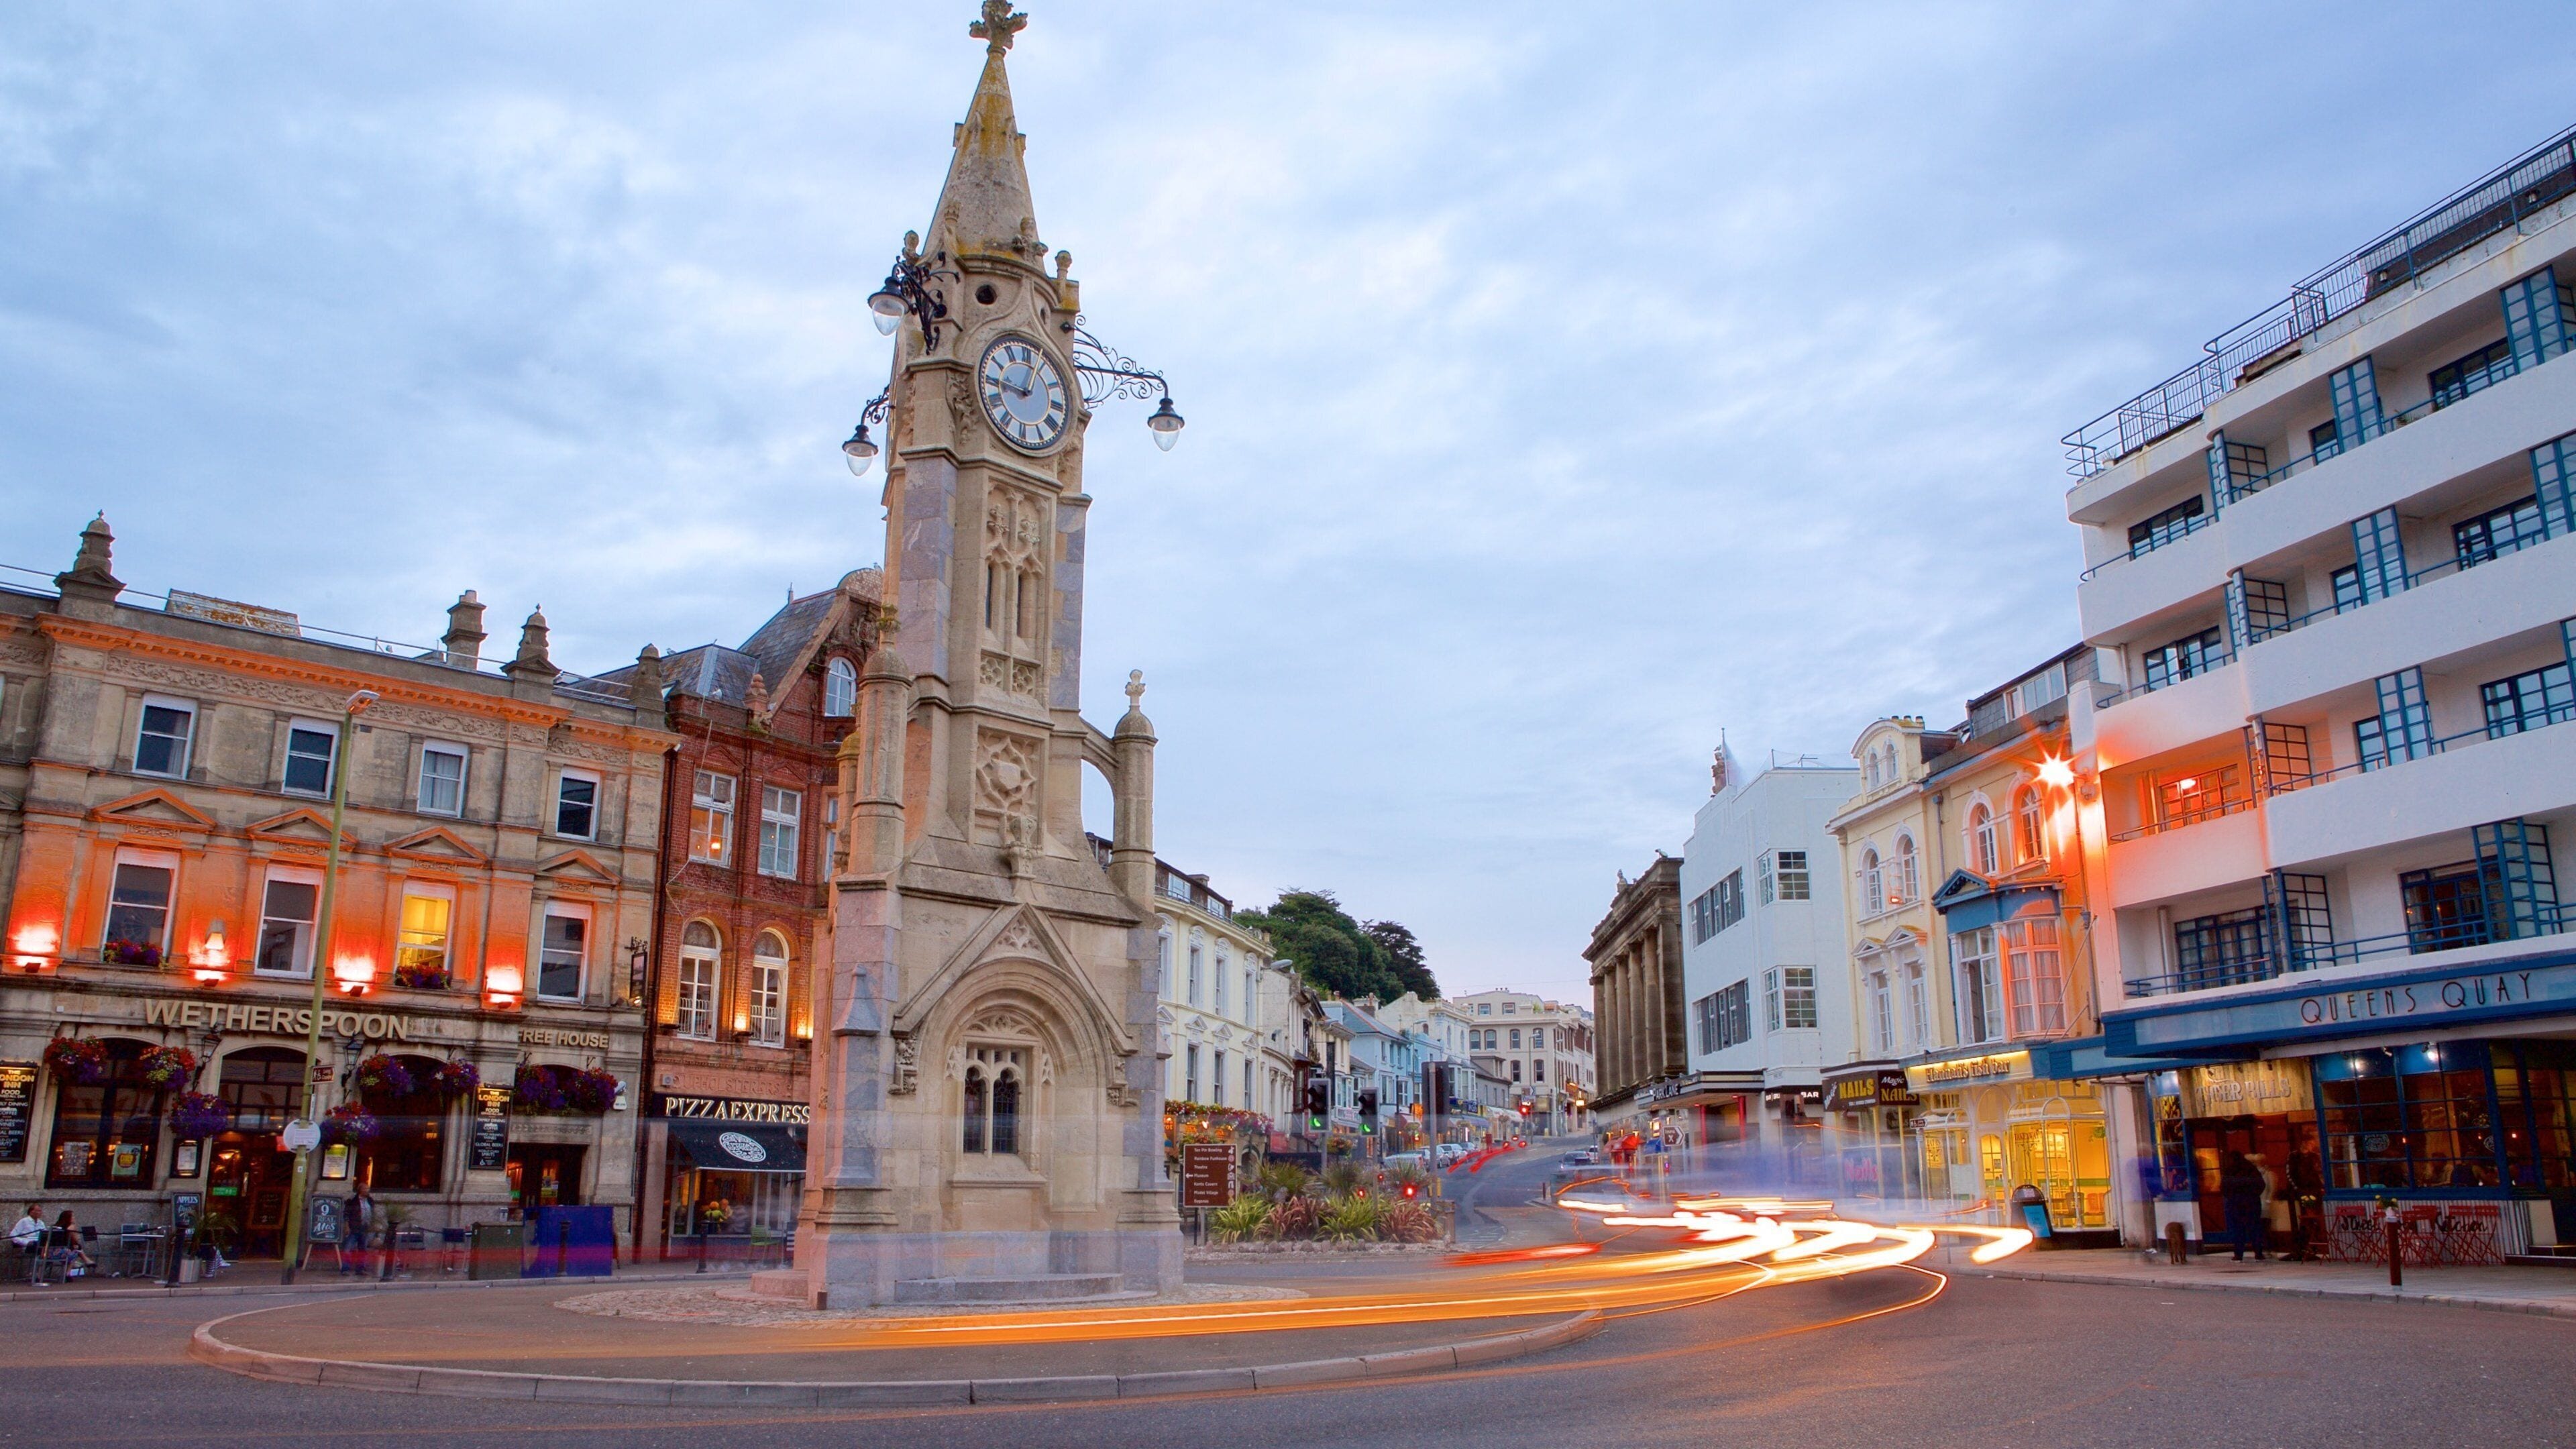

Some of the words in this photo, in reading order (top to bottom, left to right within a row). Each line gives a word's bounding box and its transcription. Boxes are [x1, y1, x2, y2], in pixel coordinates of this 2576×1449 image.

[2301, 987, 2416, 1024] QUEENS
[2442, 973, 2530, 1008] QUAY
[145, 999, 409, 1039] WETHERSPOON
[557, 1030, 609, 1048] HOUSE
[0, 1074, 35, 1082] ONDON
[1925, 1063, 1969, 1083] Hannah's
[1970, 1059, 1990, 1077] fish
[1992, 1058, 2010, 1073] bar
[1838, 1079, 1876, 1099] NAILS
[1881, 1076, 1904, 1087] Magic
[478, 1094, 510, 1102] LONDON
[1653, 1086, 1666, 1100] PARK
[1665, 1083, 1679, 1097] LANE
[1880, 1088, 1918, 1102] NAILS
[1844, 1158, 1879, 1182] Nails
[176, 1196, 199, 1204] APPLES
[321, 1204, 330, 1216] 9
[2341, 1215, 2379, 1232] Stree
